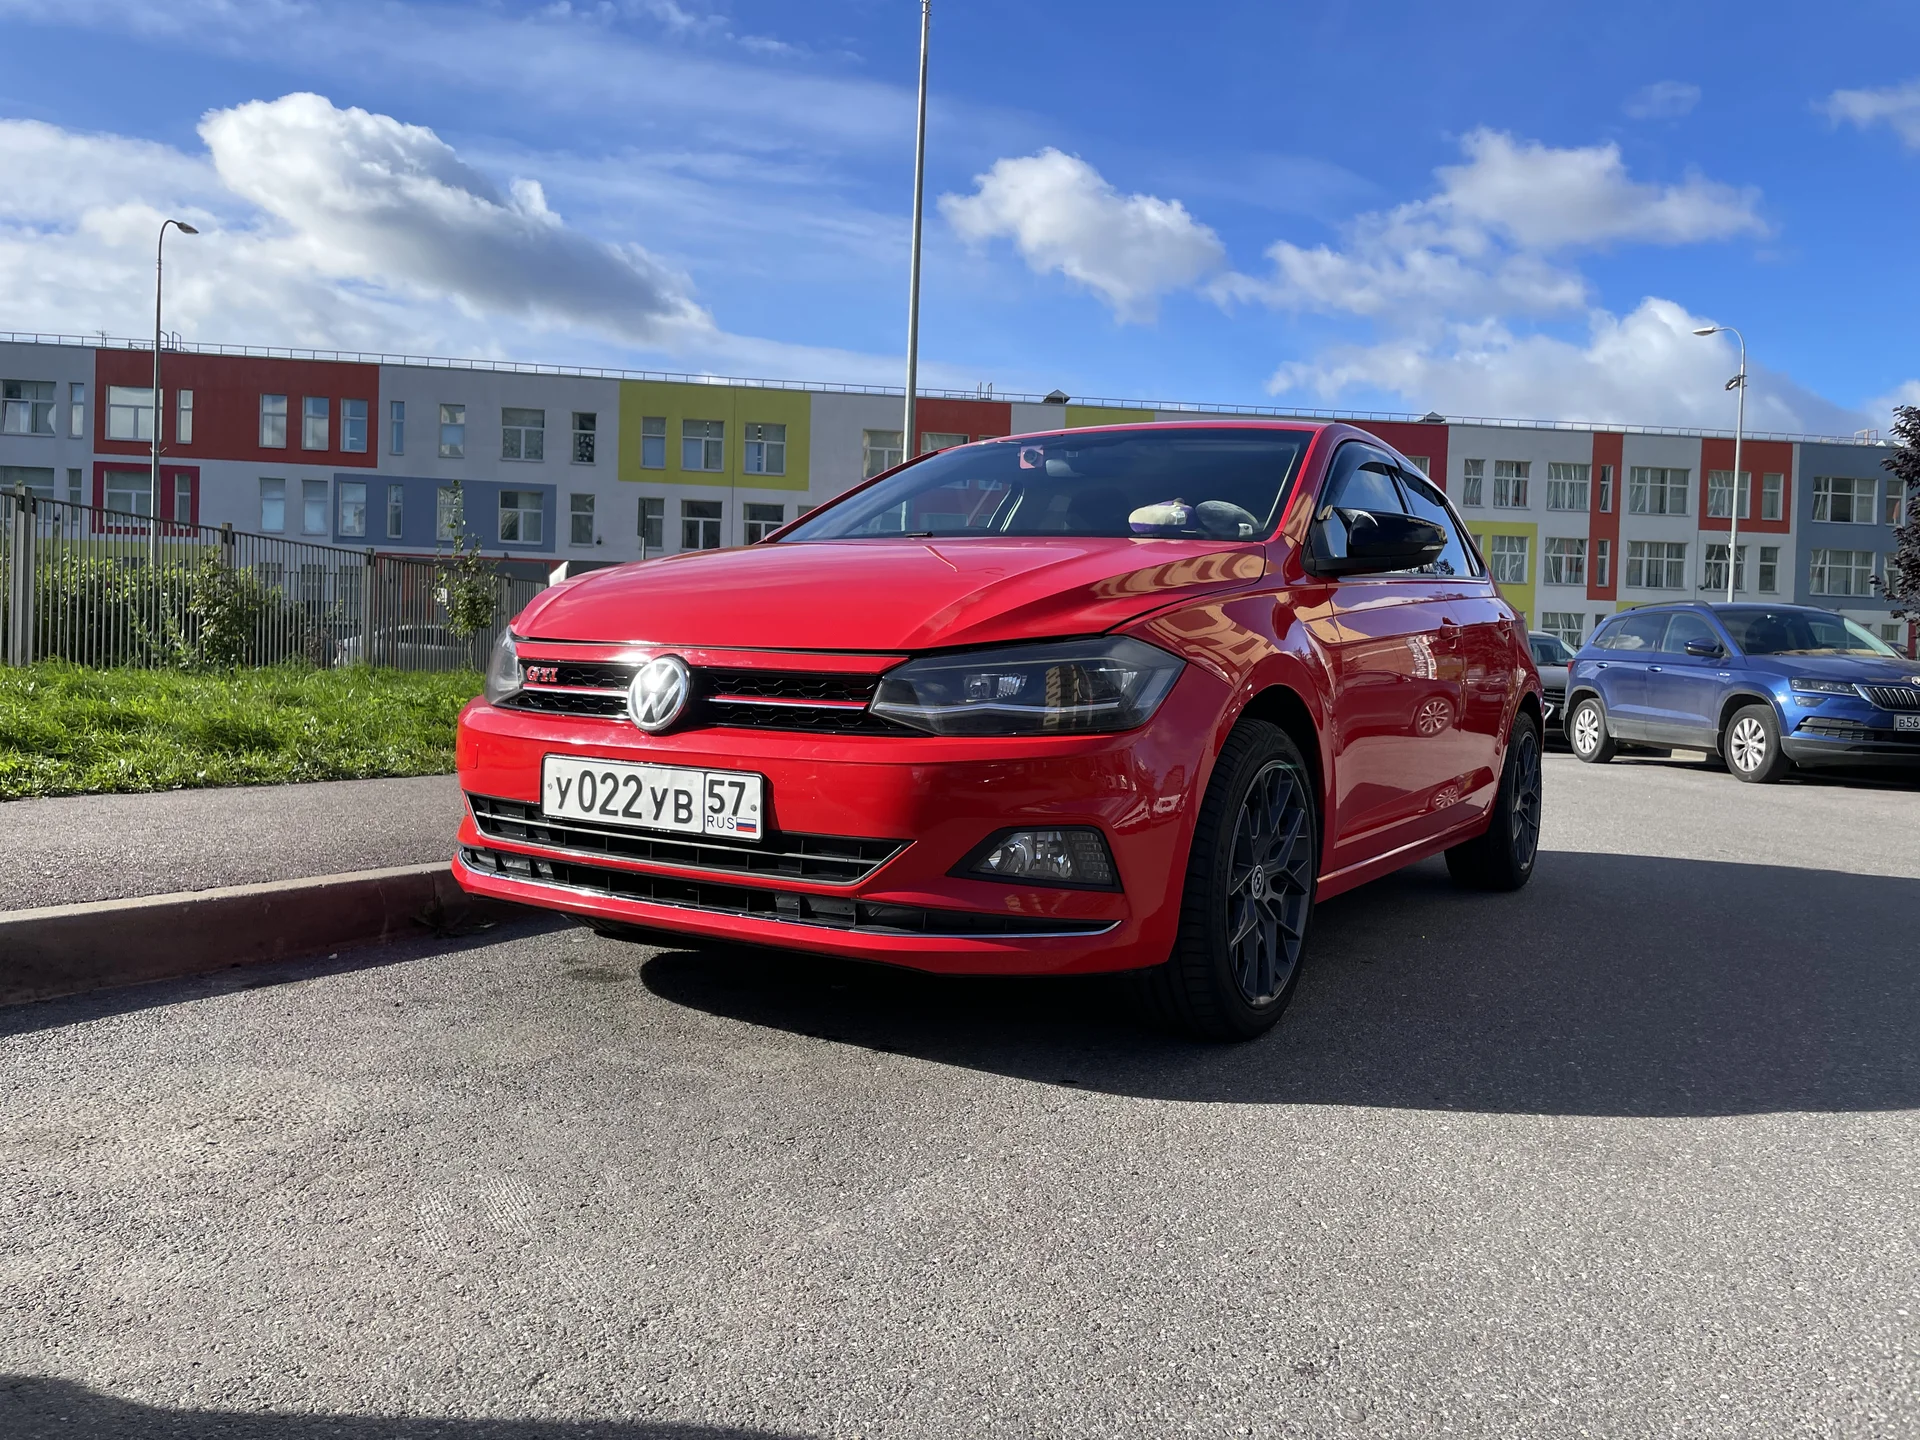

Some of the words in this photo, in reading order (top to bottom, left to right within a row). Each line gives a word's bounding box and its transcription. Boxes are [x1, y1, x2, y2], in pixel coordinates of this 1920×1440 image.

[526, 665, 559, 683] GTI
[628, 656, 689, 732] VW
[556, 769, 693, 824] У022УВ
[707, 779, 746, 817] 57
[707, 815, 735, 830] RUS
